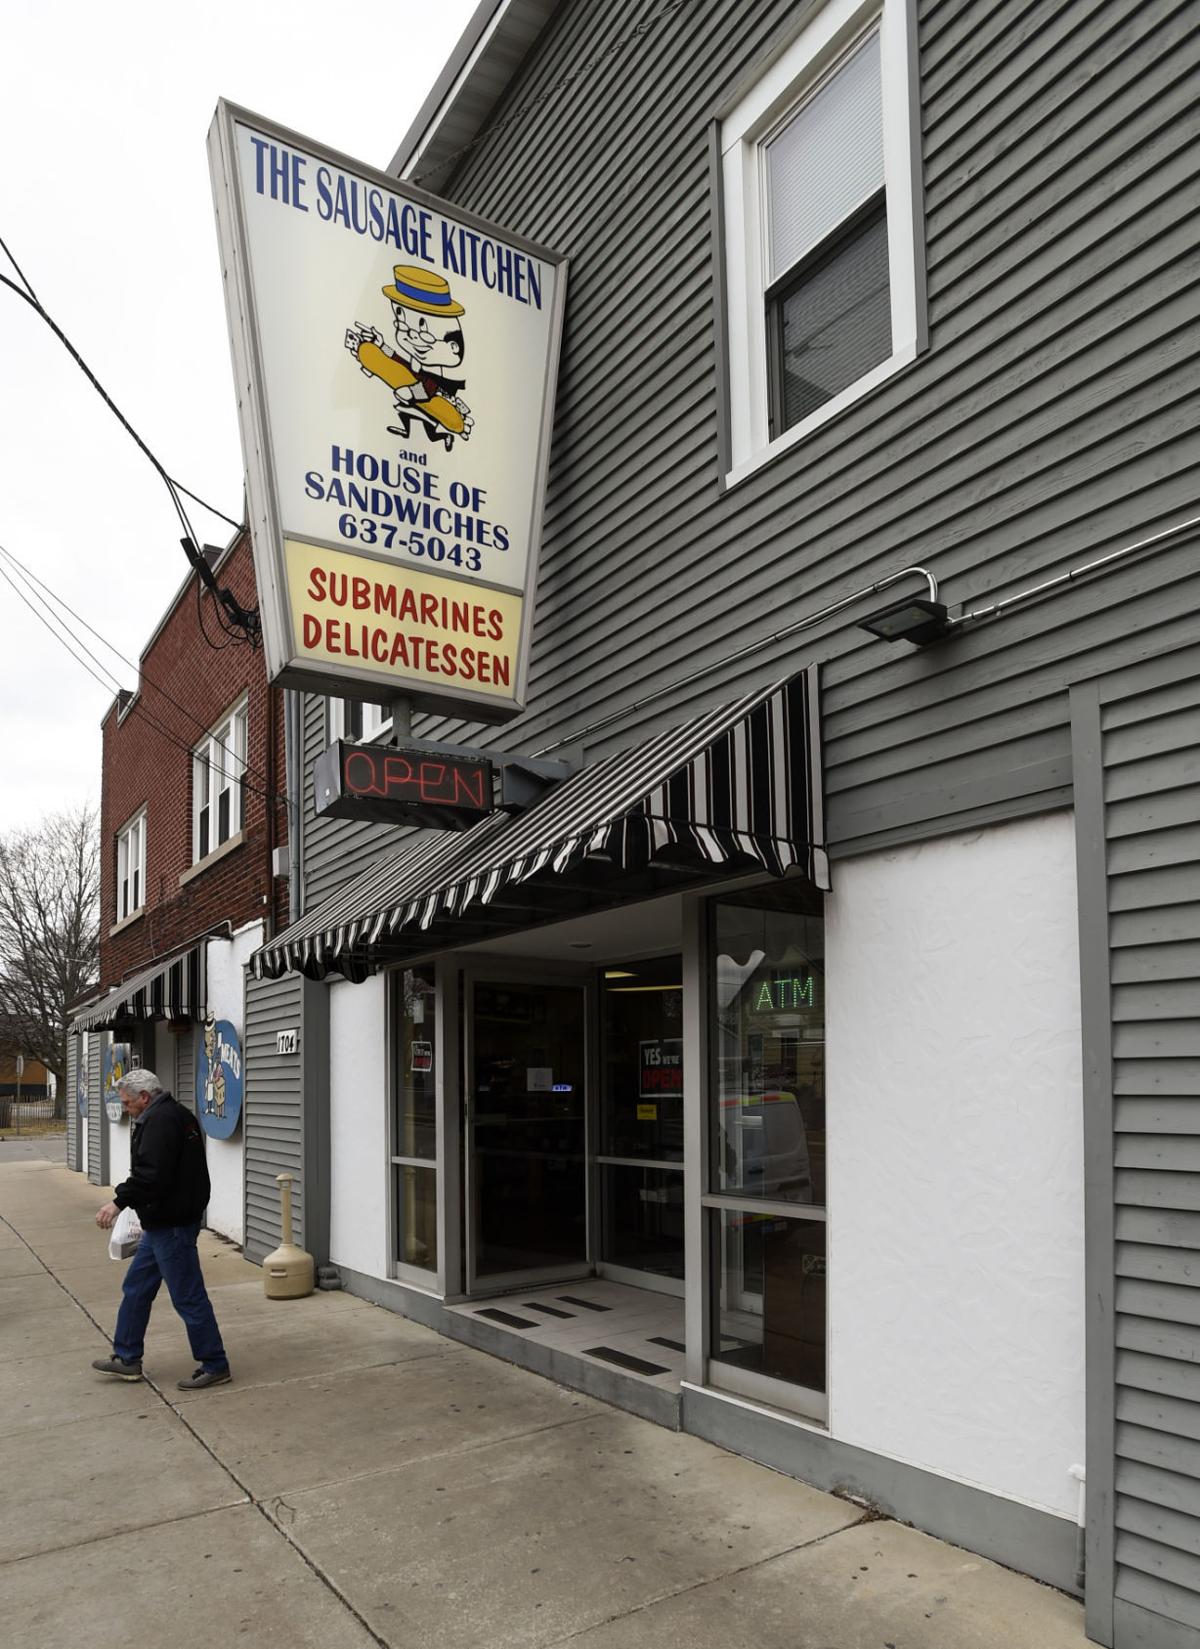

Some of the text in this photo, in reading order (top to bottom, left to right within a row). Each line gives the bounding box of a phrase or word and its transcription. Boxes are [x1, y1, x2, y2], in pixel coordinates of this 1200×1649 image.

[251, 136, 542, 310] THE SAUSAGE KITCHEN
[331, 445, 487, 513] HOUSE OF
[399, 449, 427, 466] and
[305, 471, 510, 551] SANDWICHES
[338, 513, 482, 572] 637-5043
[307, 567, 503, 641] SUBMARINES
[303, 613, 510, 687] DELICATESSEN
[345, 752, 484, 808] OPEN
[756, 976, 813, 1010] ATM
[220, 1043, 241, 1079] MEATS
[277, 1035, 294, 1053] 1704
[644, 1048, 661, 1066] YES
[642, 1070, 683, 1089] OPEN
